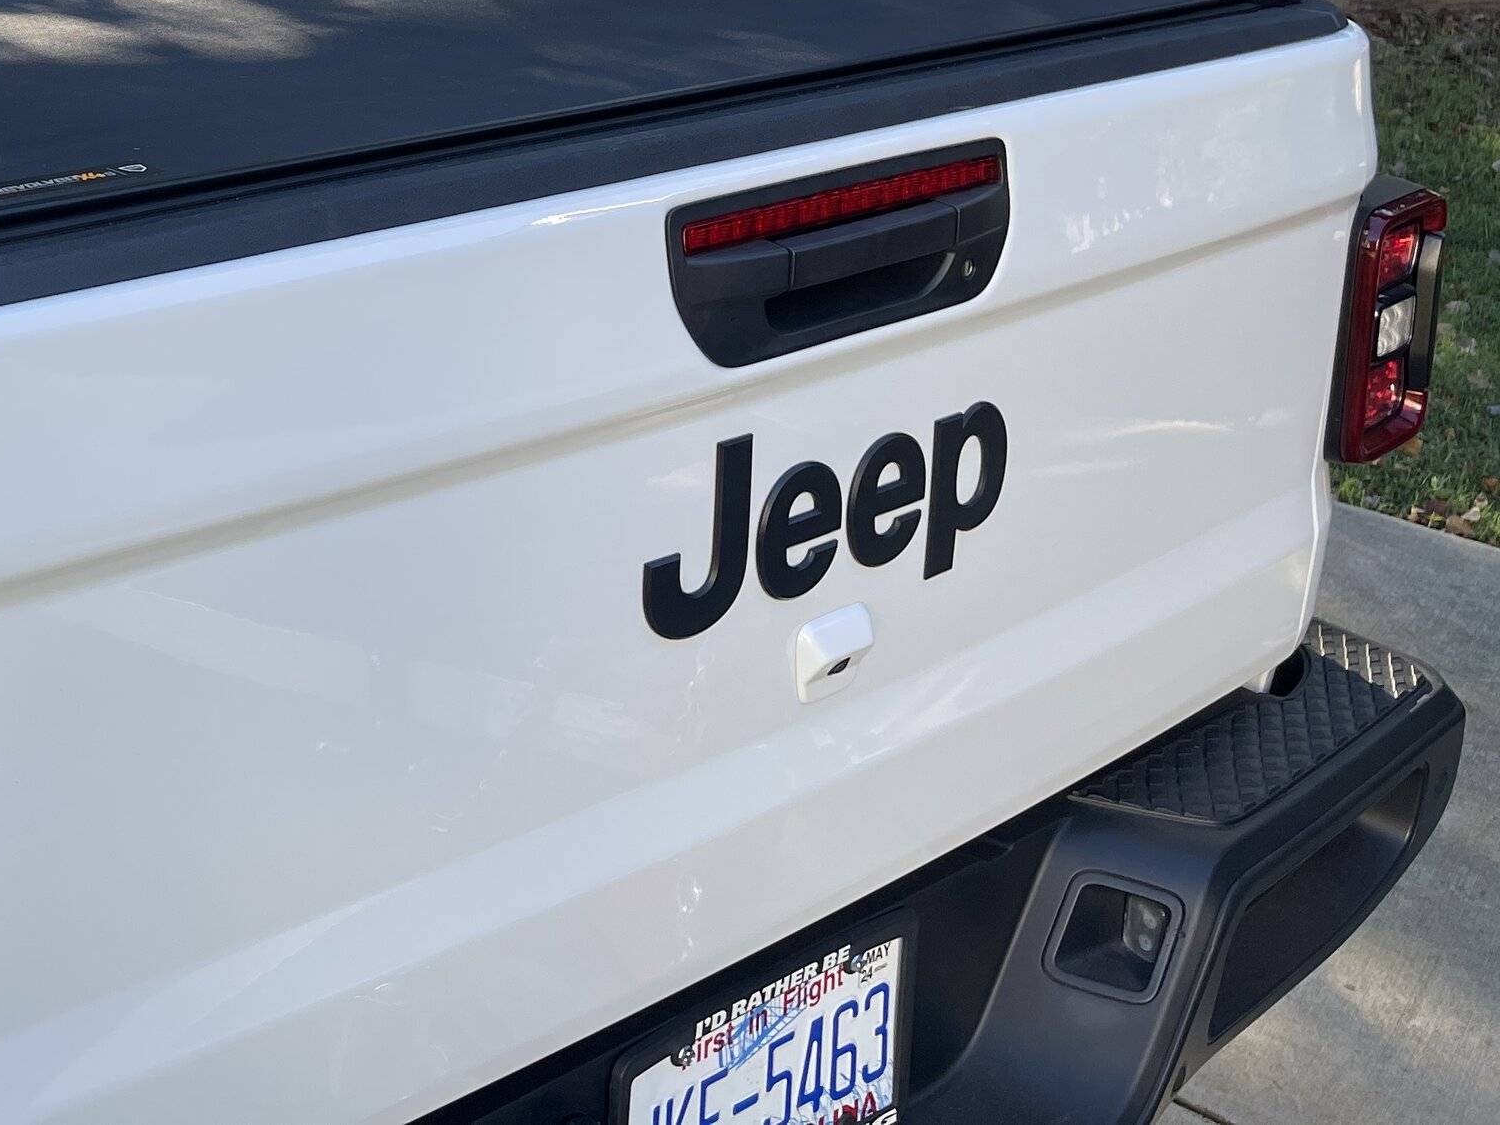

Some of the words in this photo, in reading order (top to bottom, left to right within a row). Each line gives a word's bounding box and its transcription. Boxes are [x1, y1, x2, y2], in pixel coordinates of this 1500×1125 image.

[643, 401, 1008, 640] Jeep
[731, 961, 819, 1020] RATHER
[822, 944, 852, 973] BE
[866, 941, 891, 964] MAY
[681, 1022, 735, 1071] irst
[749, 1008, 769, 1035] in
[783, 963, 844, 1016] Flight
